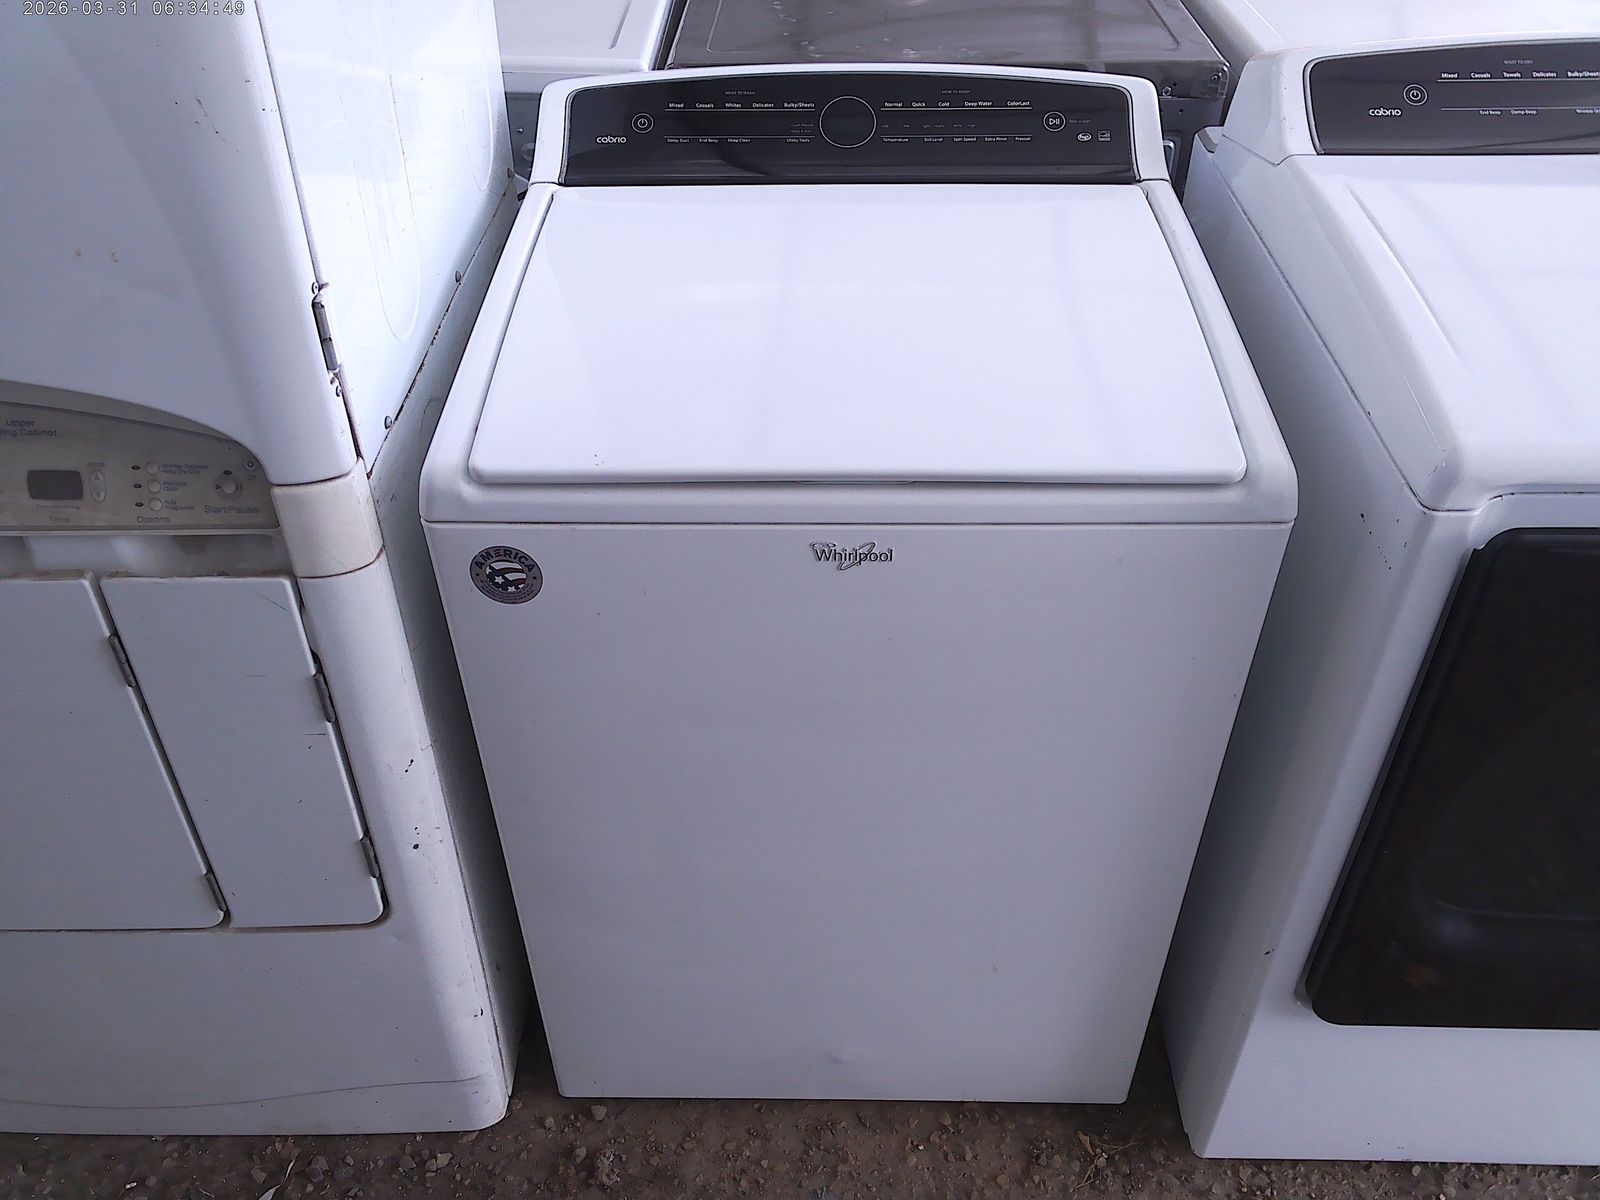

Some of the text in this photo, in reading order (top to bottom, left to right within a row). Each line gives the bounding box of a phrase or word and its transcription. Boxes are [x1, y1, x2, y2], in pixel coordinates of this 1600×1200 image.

[1369, 107, 1402, 116] cabrio
[596, 135, 627, 144] cabrio
[204, 506, 260, 514] Start/Pause
[474, 548, 536, 572] AMERICA
[813, 547, 894, 566] Whirlpool
